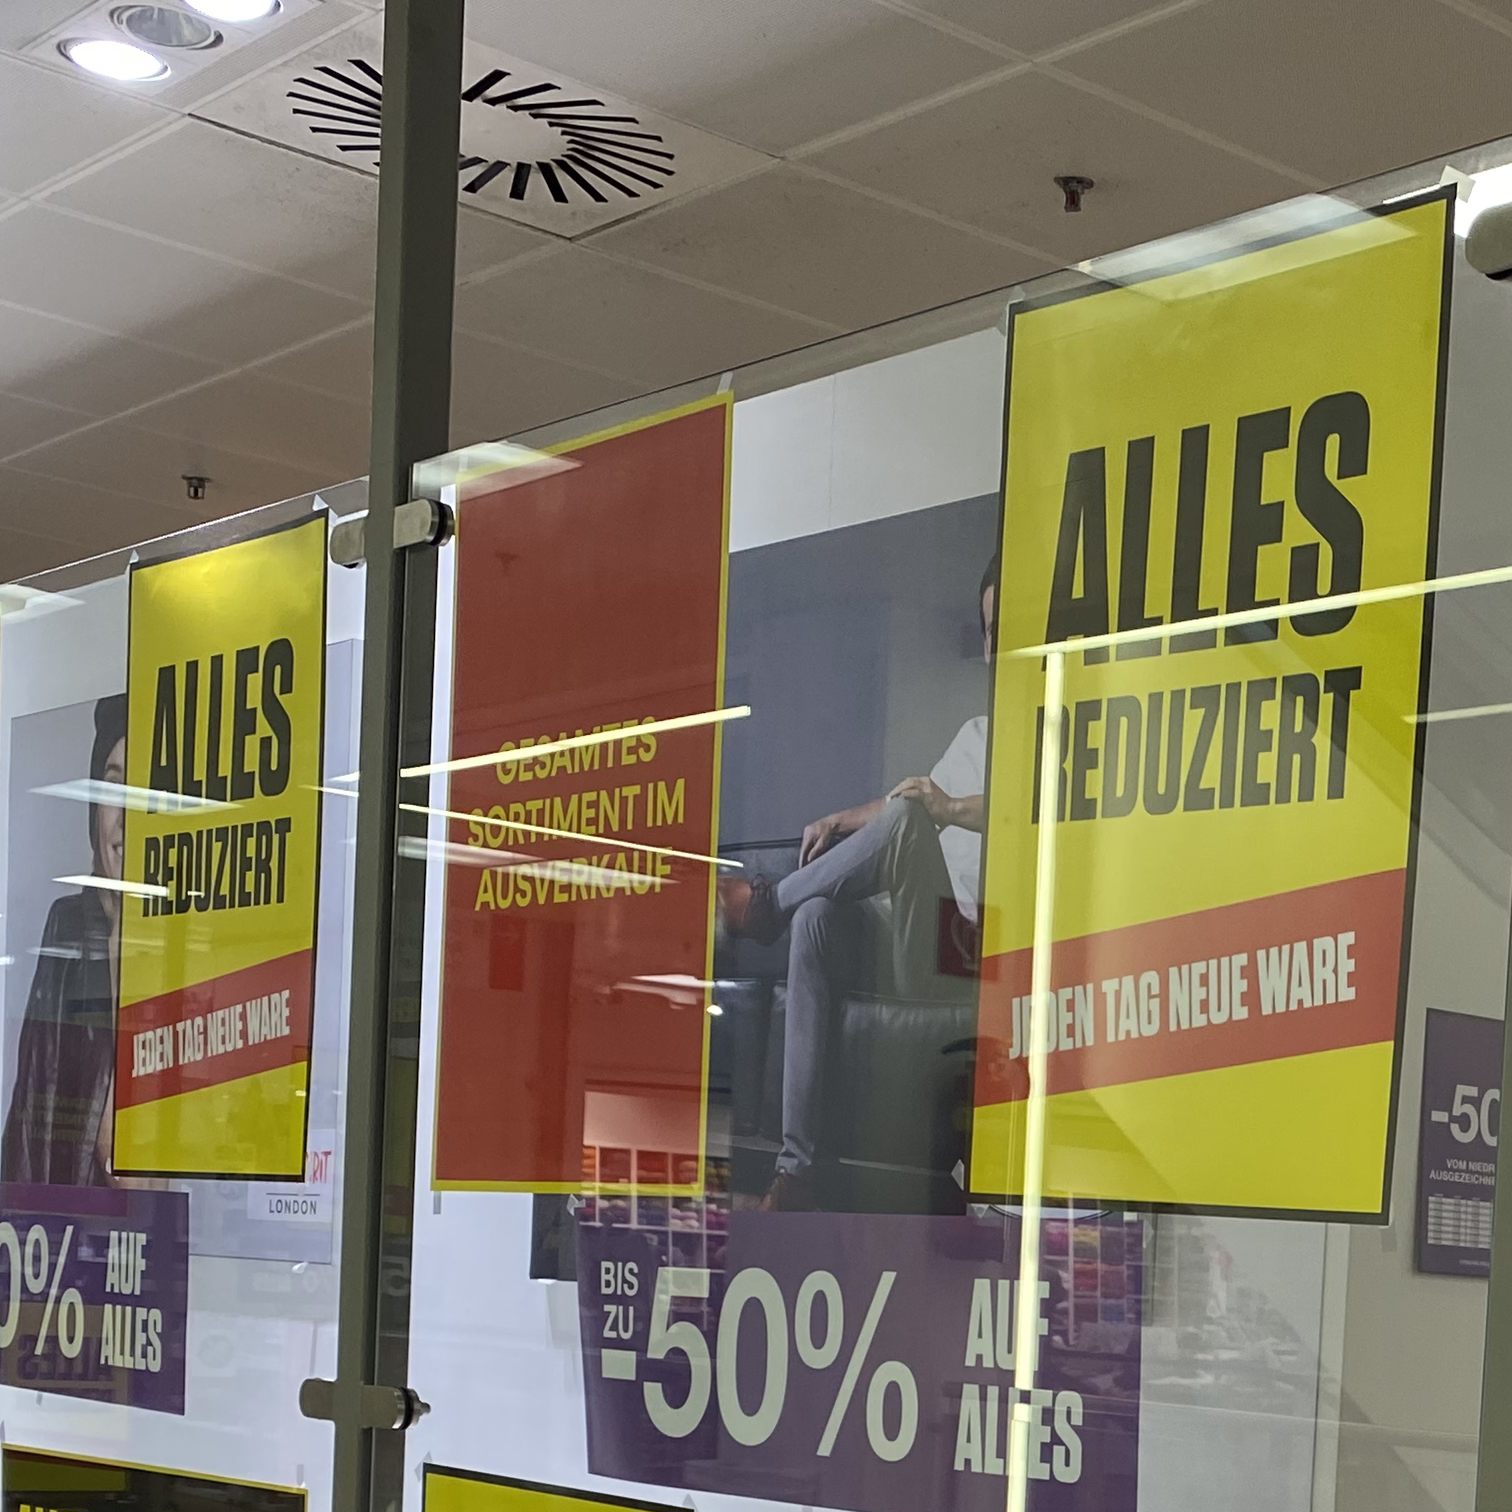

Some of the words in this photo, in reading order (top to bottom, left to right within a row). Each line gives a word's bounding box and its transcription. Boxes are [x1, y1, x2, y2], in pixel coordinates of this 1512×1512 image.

[1042, 391, 1371, 673] ALLES
[148, 637, 295, 814] ALLES
[496, 716, 657, 784] GESAMTES
[1031, 665, 1362, 825] REDUZIERT
[468, 785, 641, 848] SORTIMENT
[647, 778, 685, 827] IM
[142, 817, 292, 918] REDUZIERT
[475, 847, 672, 911] AUSVERKAUF
[1102, 970, 1161, 1042] TAG
[1168, 952, 1249, 1031] NEUE
[1256, 931, 1356, 1016] WARE
[132, 1025, 174, 1078] JEDEN
[176, 1016, 204, 1066] TAG
[207, 1004, 243, 1057] NEUE
[246, 989, 291, 1046] WARE
[1446, 1158, 1467, 1171] VOM
[269, 1199, 317, 1215] LONDON
[105, 1230, 147, 1295] AUF
[601, 1261, 638, 1297] BIS
[100, 1303, 163, 1373] ALLES
[603, 1305, 635, 1340] ZU
[601, 1267, 918, 1463] -50%
